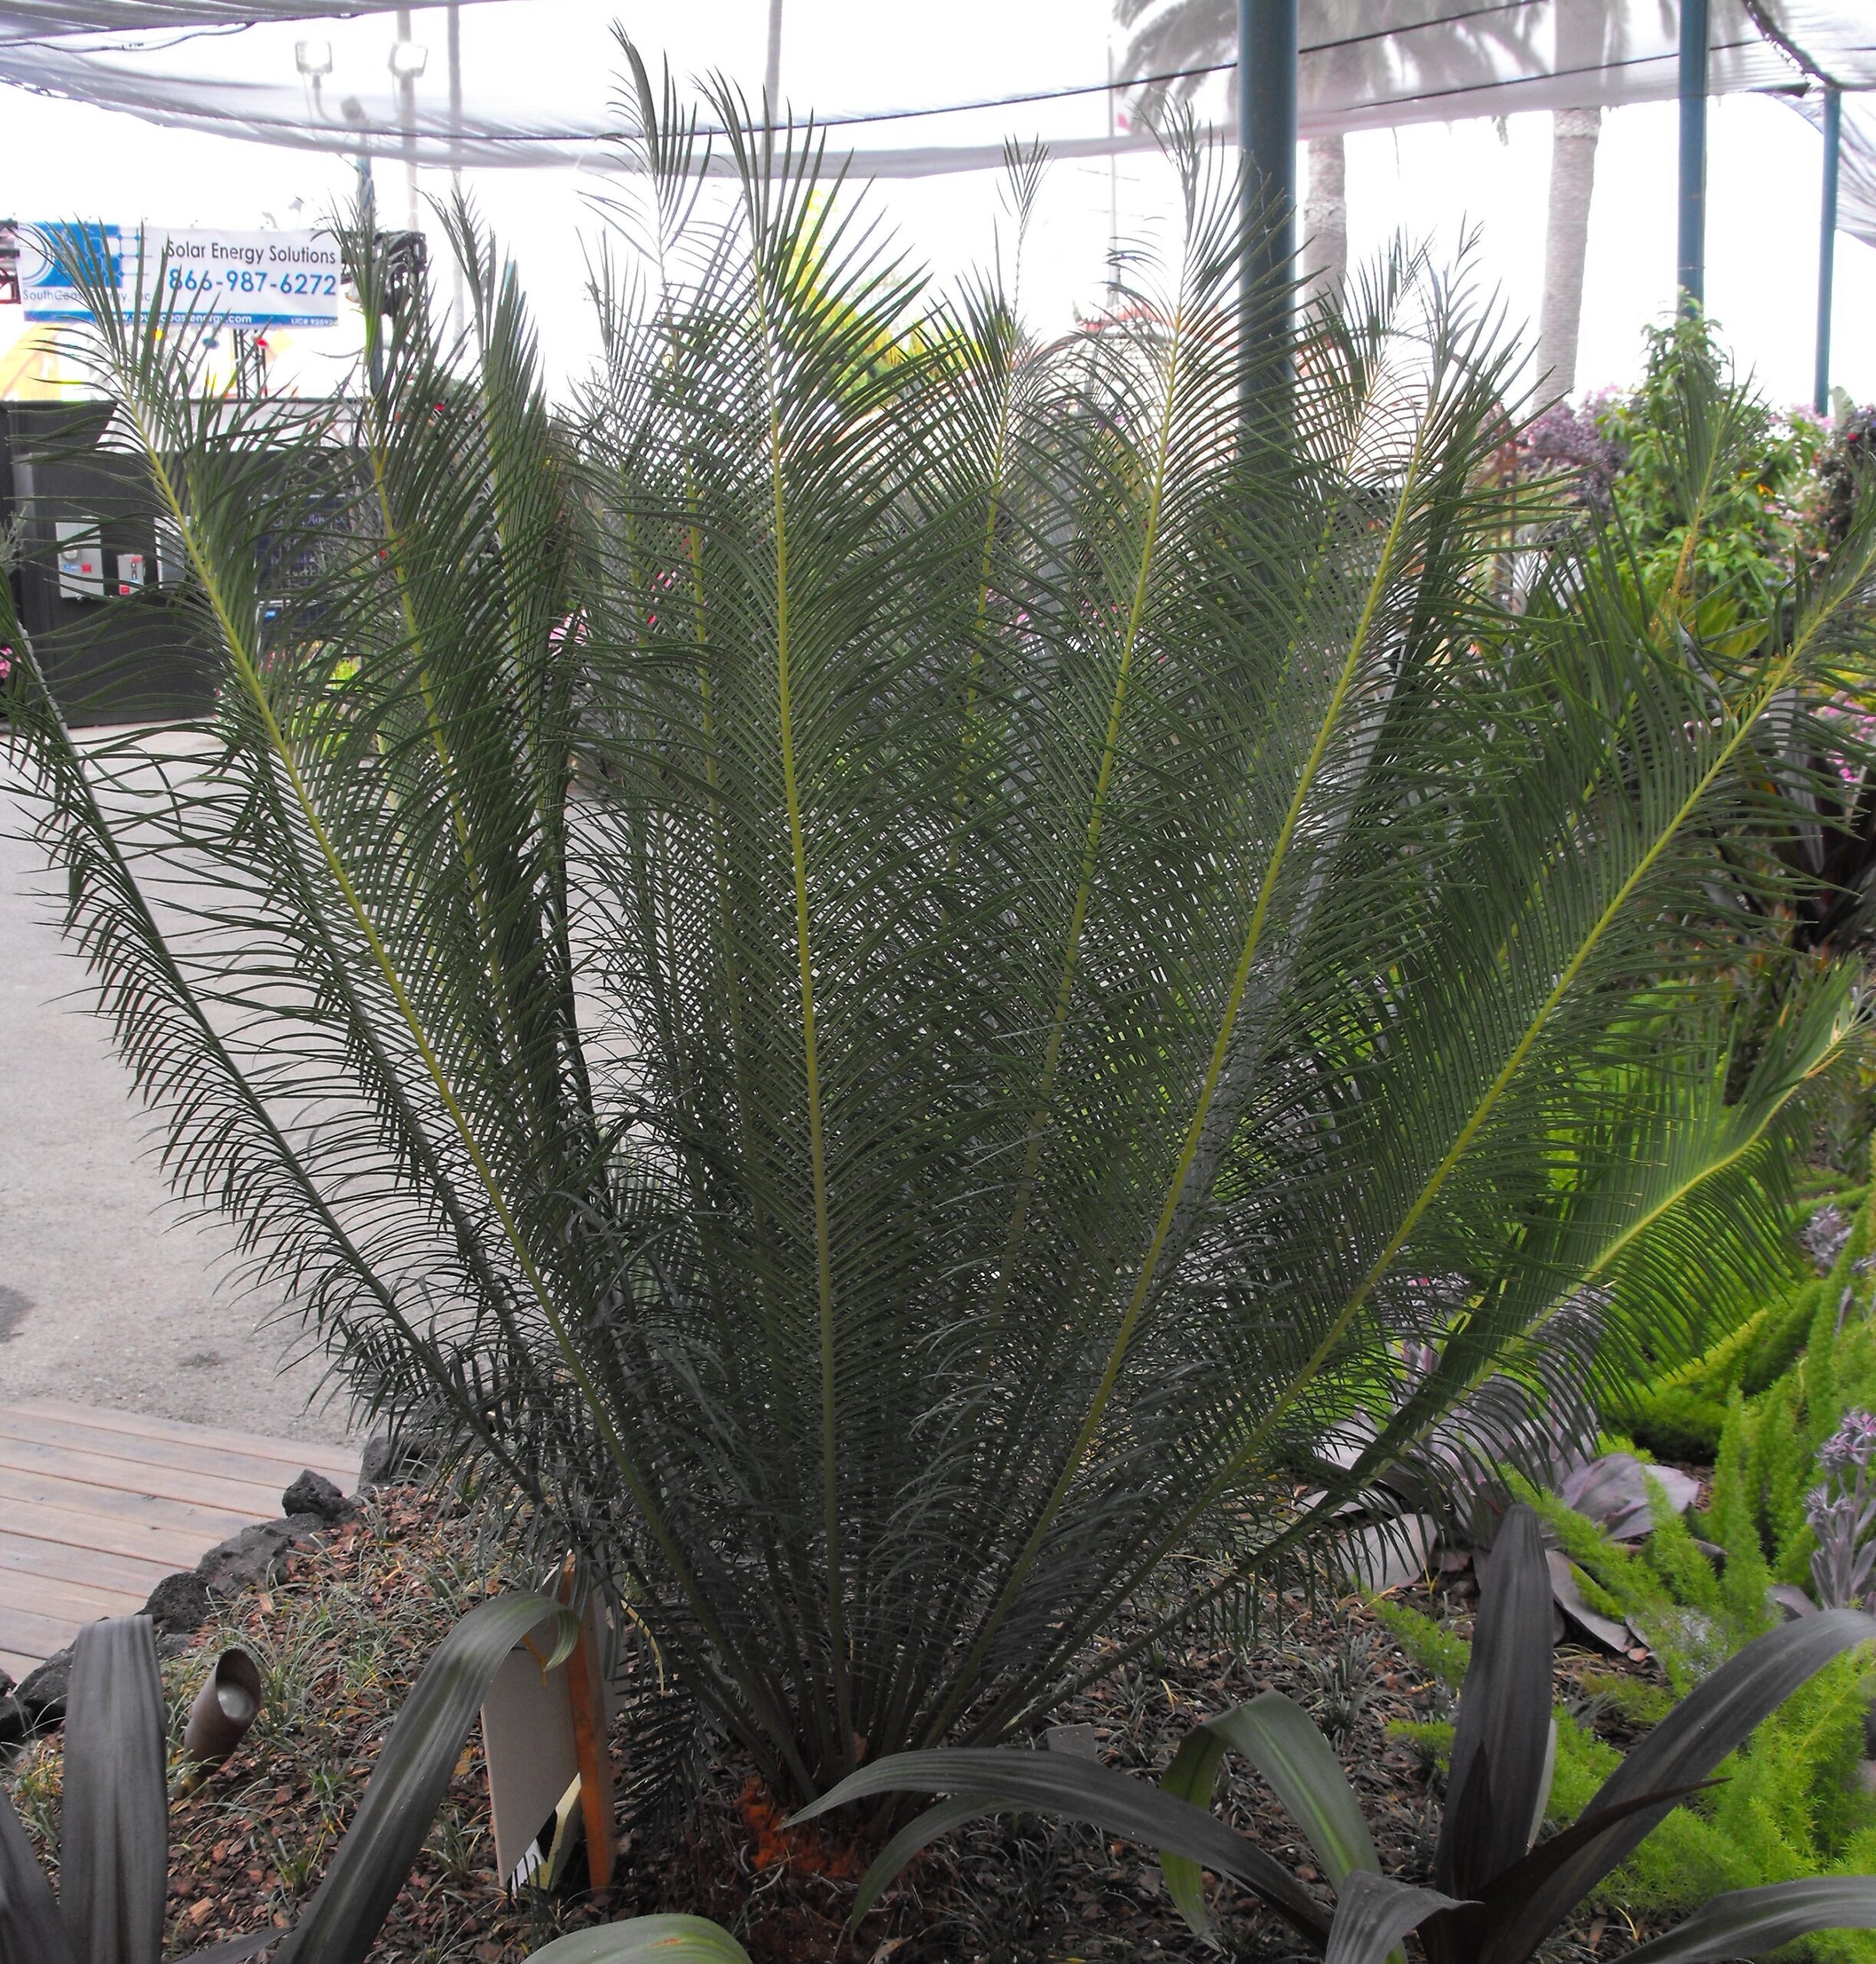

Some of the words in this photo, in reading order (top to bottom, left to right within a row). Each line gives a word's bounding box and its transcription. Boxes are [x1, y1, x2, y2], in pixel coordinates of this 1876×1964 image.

[168, 242, 206, 259] Solar
[211, 242, 265, 265] Energy
[269, 246, 336, 265] Solutions
[169, 269, 337, 296] 866-987-6272
